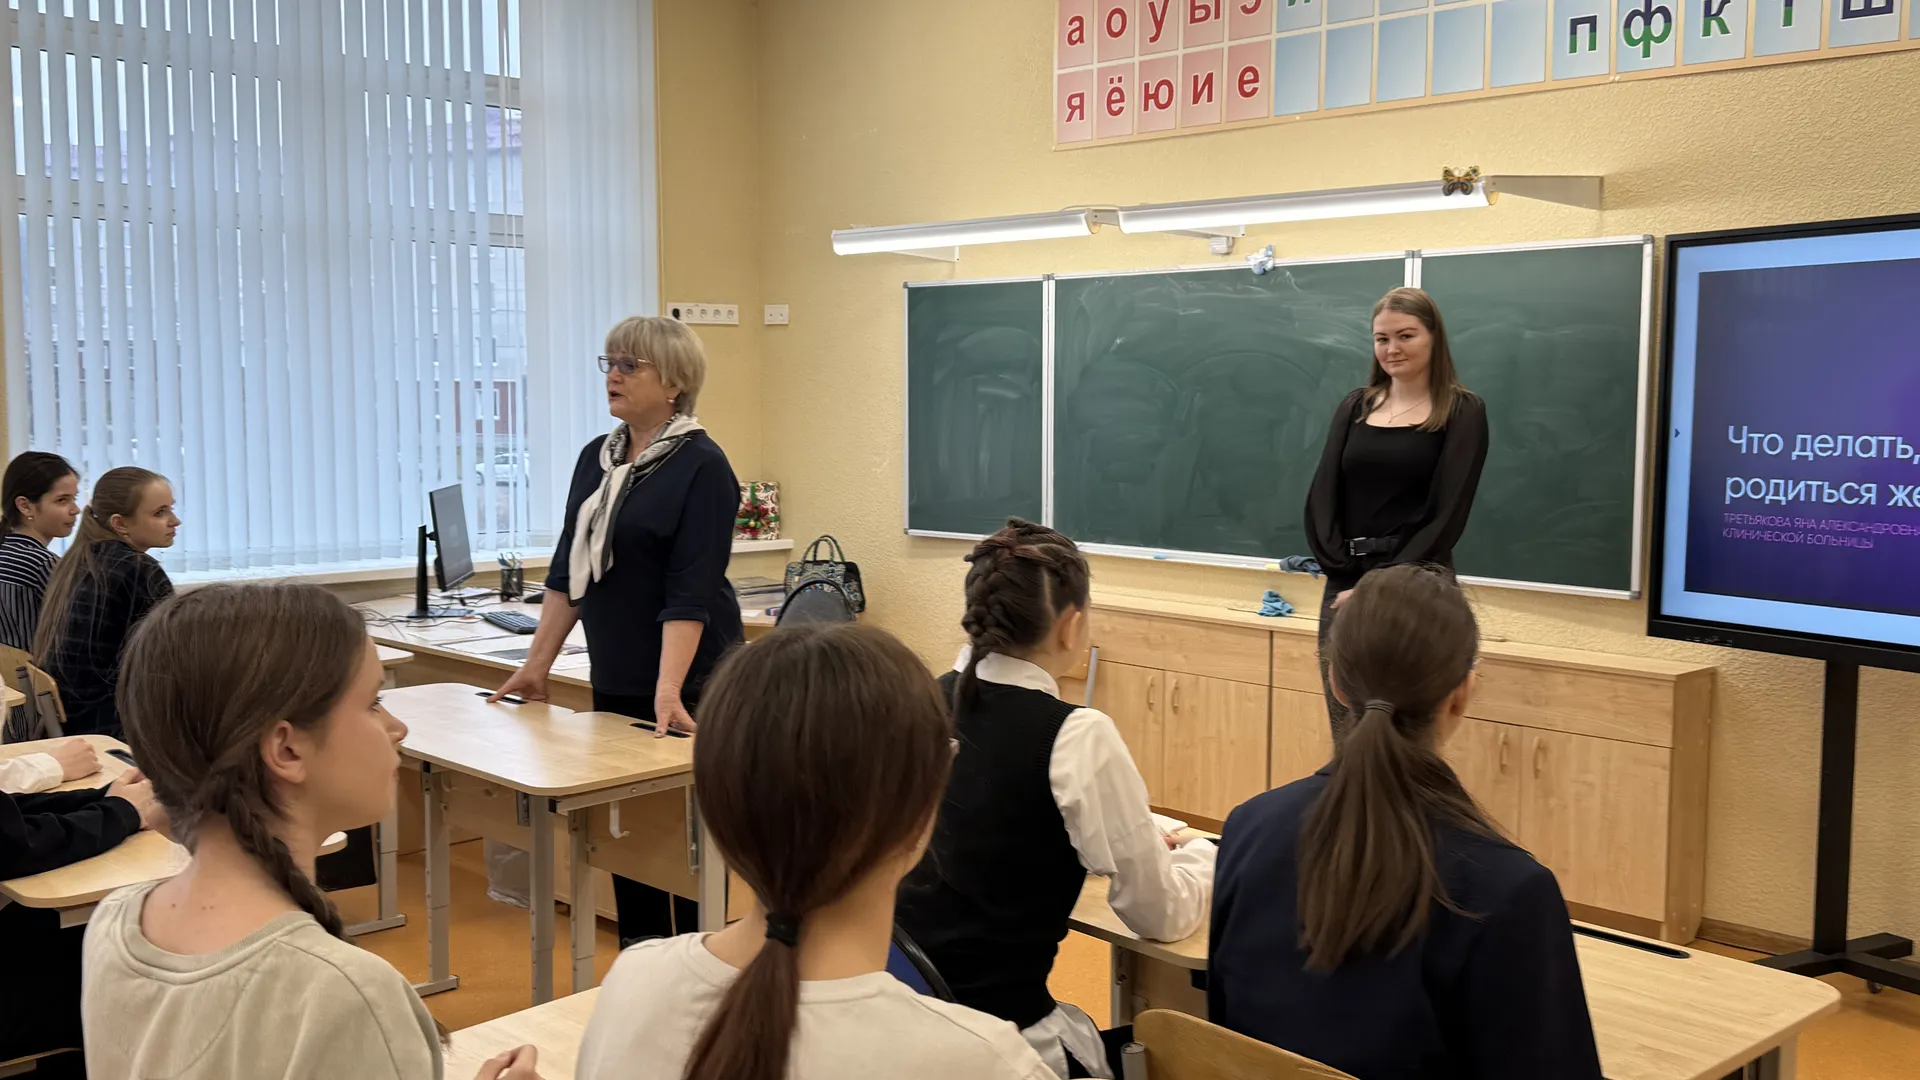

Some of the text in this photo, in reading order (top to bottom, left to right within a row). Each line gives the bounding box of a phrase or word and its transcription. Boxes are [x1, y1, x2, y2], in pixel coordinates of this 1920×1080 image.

[1067, 15, 1084, 45] а
[1568, 15, 1597, 54] п
[1623, 0, 1672, 58] ф
[1065, 66, 1260, 122] я ё ю и е
[1728, 426, 1920, 465] Что делать,
[1725, 477, 1877, 505] родиться
[1722, 527, 1804, 544] КЛИНИЧЕСКОЙ
[1723, 512, 1791, 528] ТРЕТЬЯКОВА
[1793, 517, 1817, 530] ЯНА
